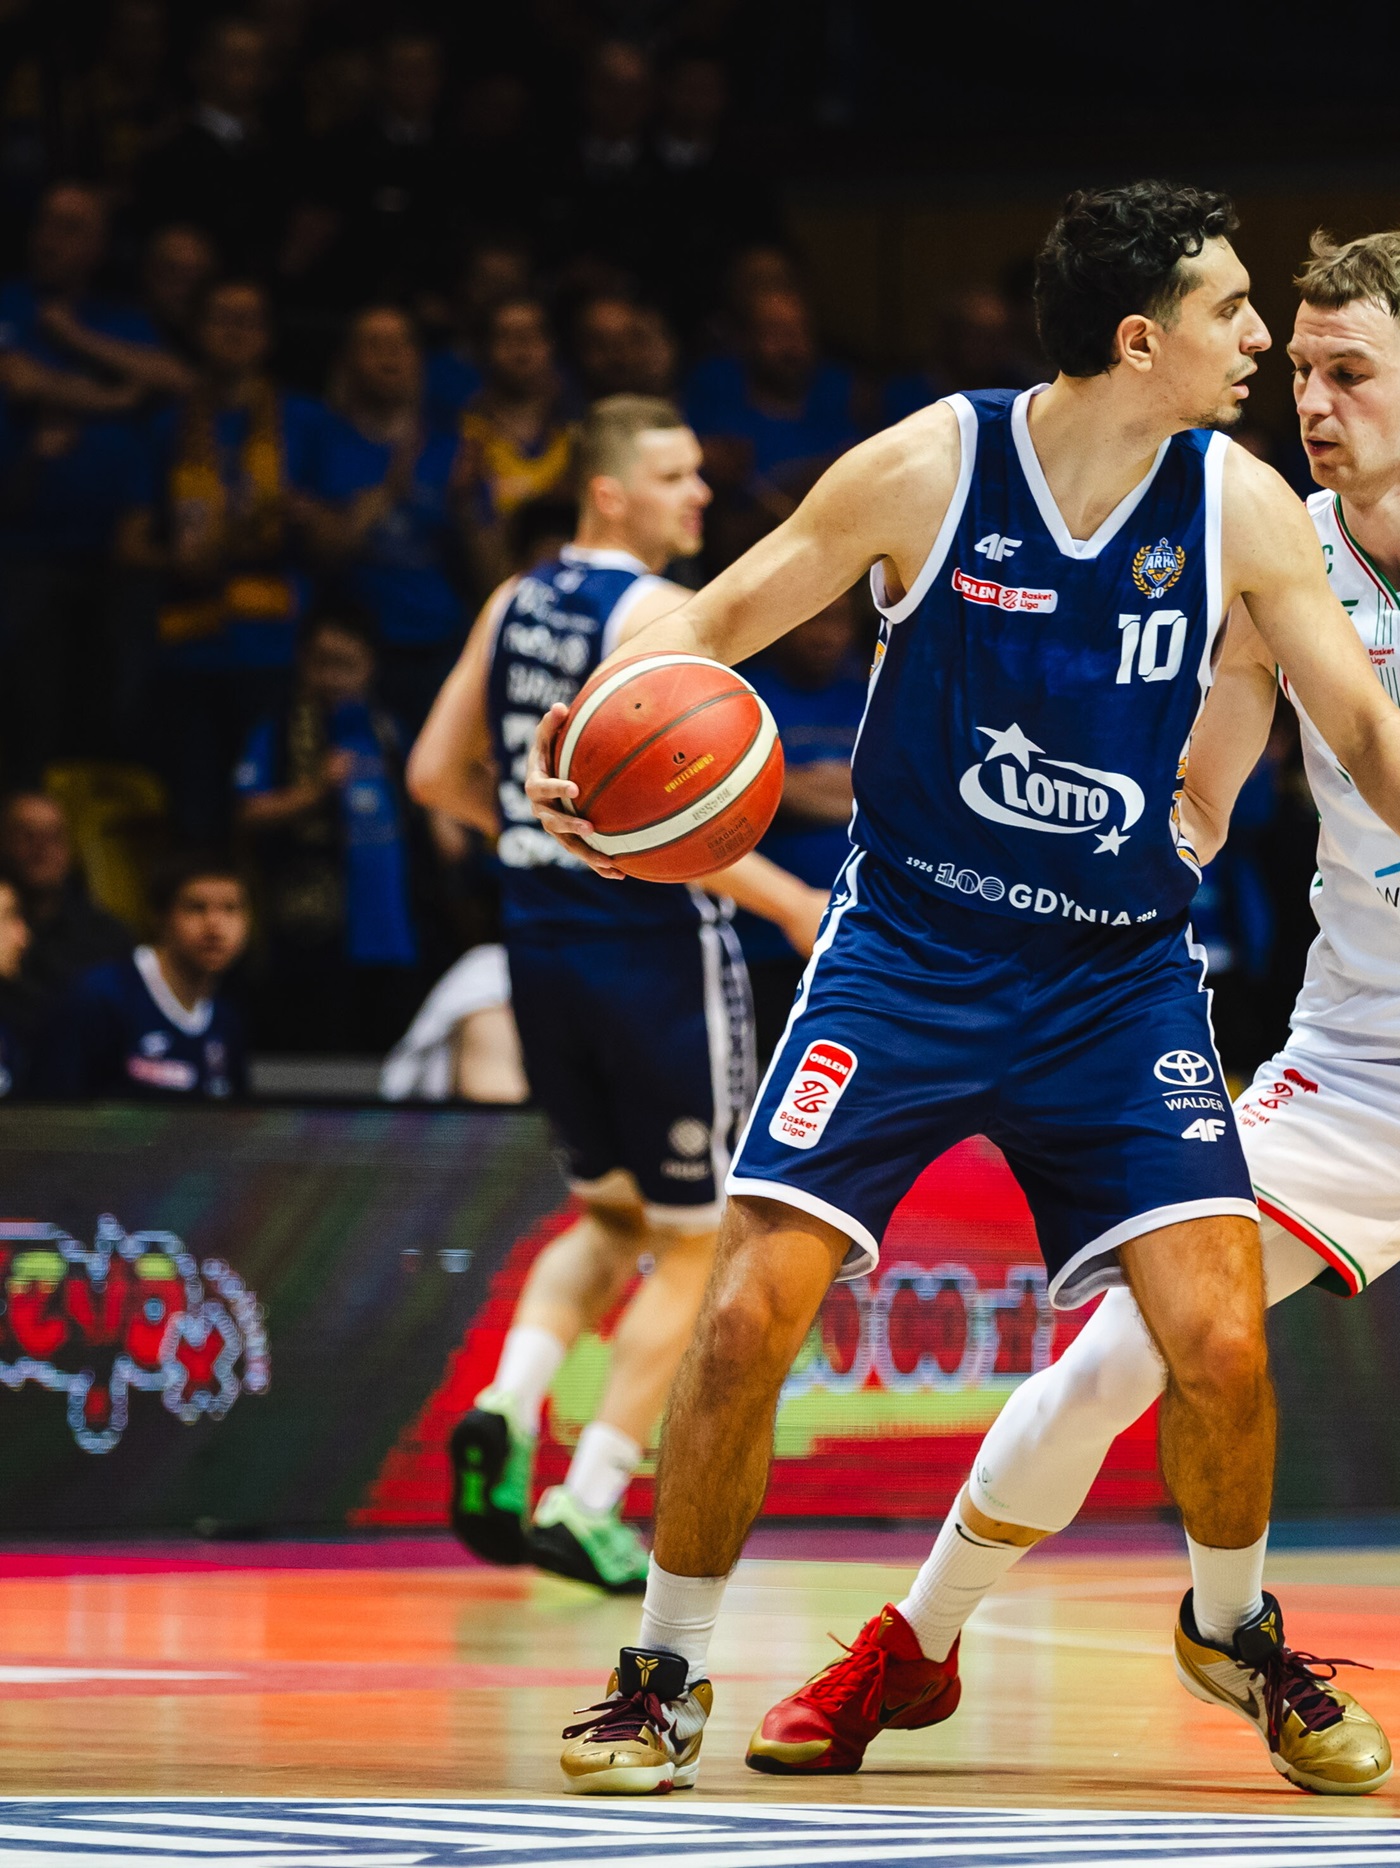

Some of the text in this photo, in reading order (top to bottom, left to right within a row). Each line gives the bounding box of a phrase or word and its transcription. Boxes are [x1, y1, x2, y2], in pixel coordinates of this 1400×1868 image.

[974, 533, 1022, 562] 4F
[1020, 601, 1038, 610] Liga
[1021, 591, 1052, 600] Basket
[1116, 609, 1187, 684] 10
[1368, 648, 1395, 656] Basket
[1000, 763, 1110, 822] LOTTO
[906, 856, 1158, 926] 1926 100 GDYNIA 2026
[808, 1052, 850, 1076] ORLEN
[1164, 1096, 1226, 1113] WALDER
[779, 1111, 818, 1131] Basket
[782, 1122, 806, 1138] Liga
[1181, 1118, 1226, 1142] 4F
